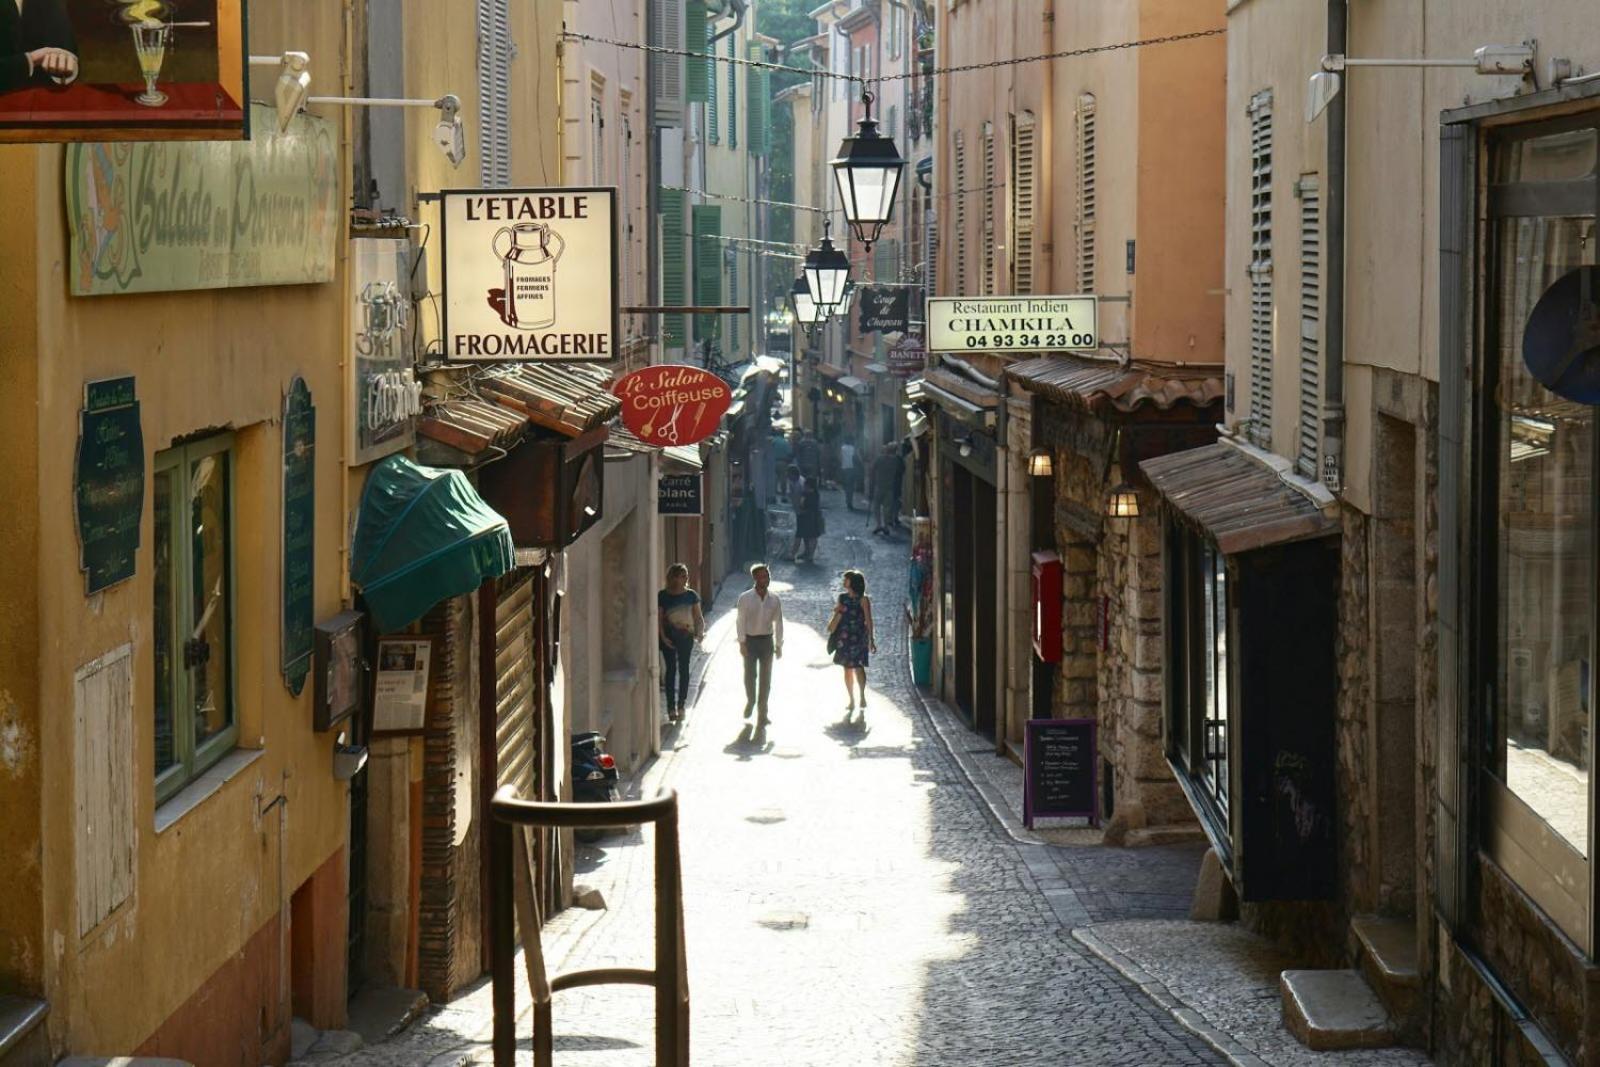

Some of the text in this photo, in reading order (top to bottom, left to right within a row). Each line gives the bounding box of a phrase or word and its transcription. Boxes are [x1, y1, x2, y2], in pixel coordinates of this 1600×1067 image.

[465, 196, 588, 221] L'ETABLE
[516, 276, 551, 284] FROMAGES
[953, 299, 1069, 315] Restaurant Indien
[948, 317, 1074, 333] CHAMKILA
[455, 333, 608, 356] FROMAGERIE
[966, 333, 1093, 348] 04 93 34 23 00
[890, 350, 929, 359] BANETT
[618, 367, 705, 398] Le Salon
[633, 385, 724, 411] Coiffeuse
[658, 487, 697, 498] blanc
